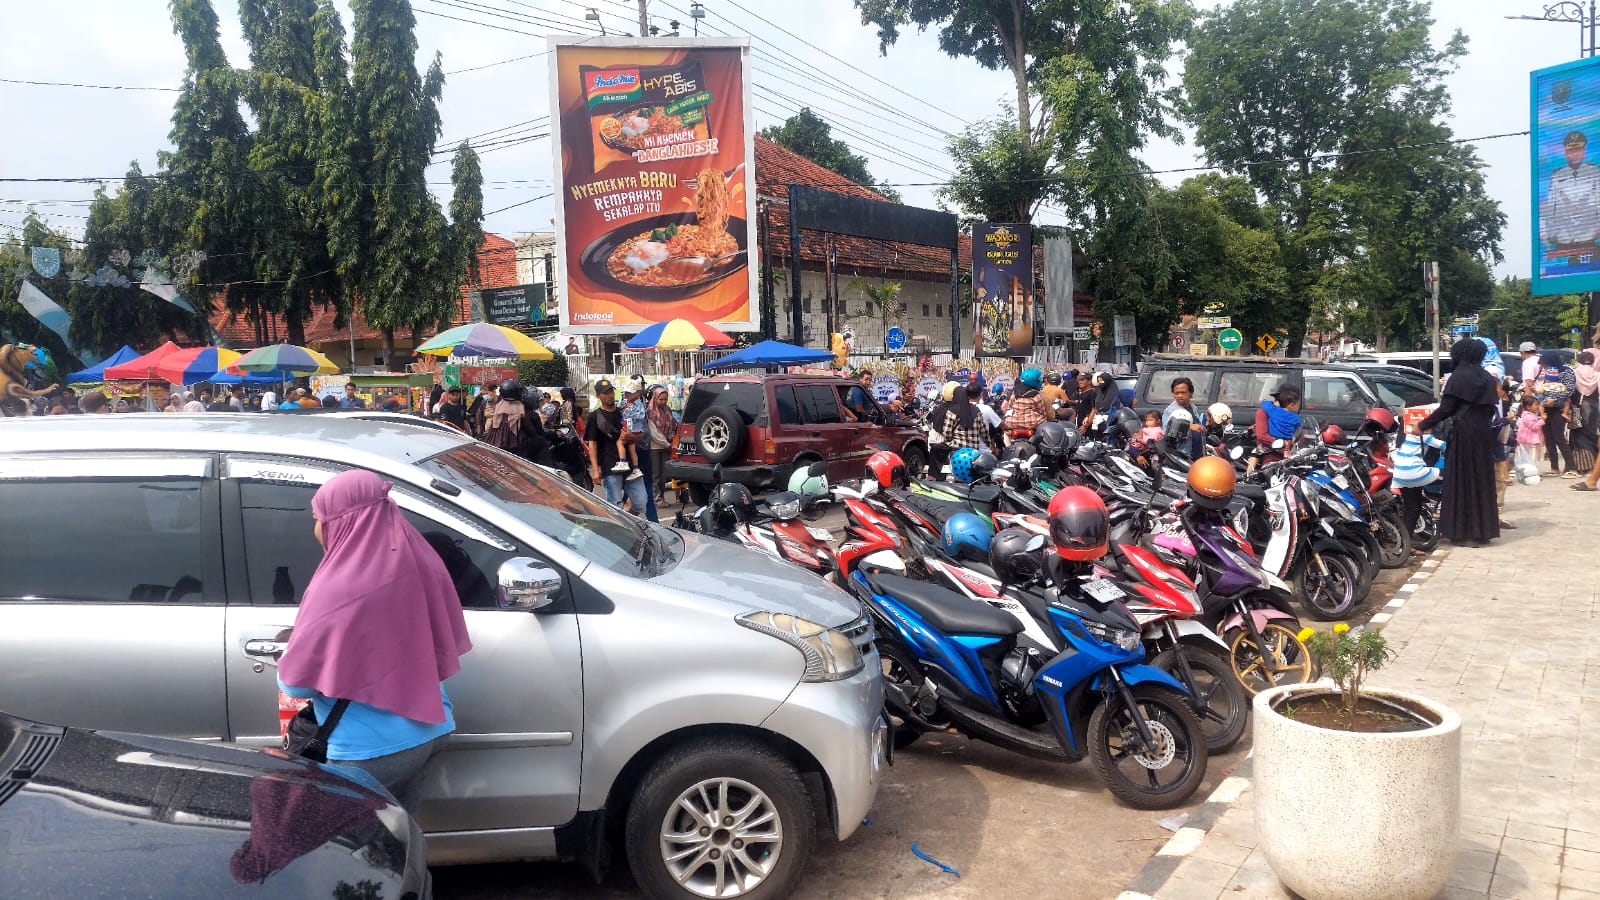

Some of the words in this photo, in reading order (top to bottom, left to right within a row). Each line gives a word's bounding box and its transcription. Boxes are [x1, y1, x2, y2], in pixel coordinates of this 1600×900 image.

[643, 72, 682, 91] HYPE
[664, 79, 696, 98] ABIS
[570, 176, 638, 201] NYEMEKNYA
[639, 171, 677, 189] BARU
[594, 189, 663, 211] REMPAHNYA
[603, 203, 646, 222] SEKALAP
[646, 202, 660, 214] ITU
[573, 312, 614, 321] Indofood
[253, 470, 305, 480] XENIA
[1042, 674, 1063, 688] YAMAHA
